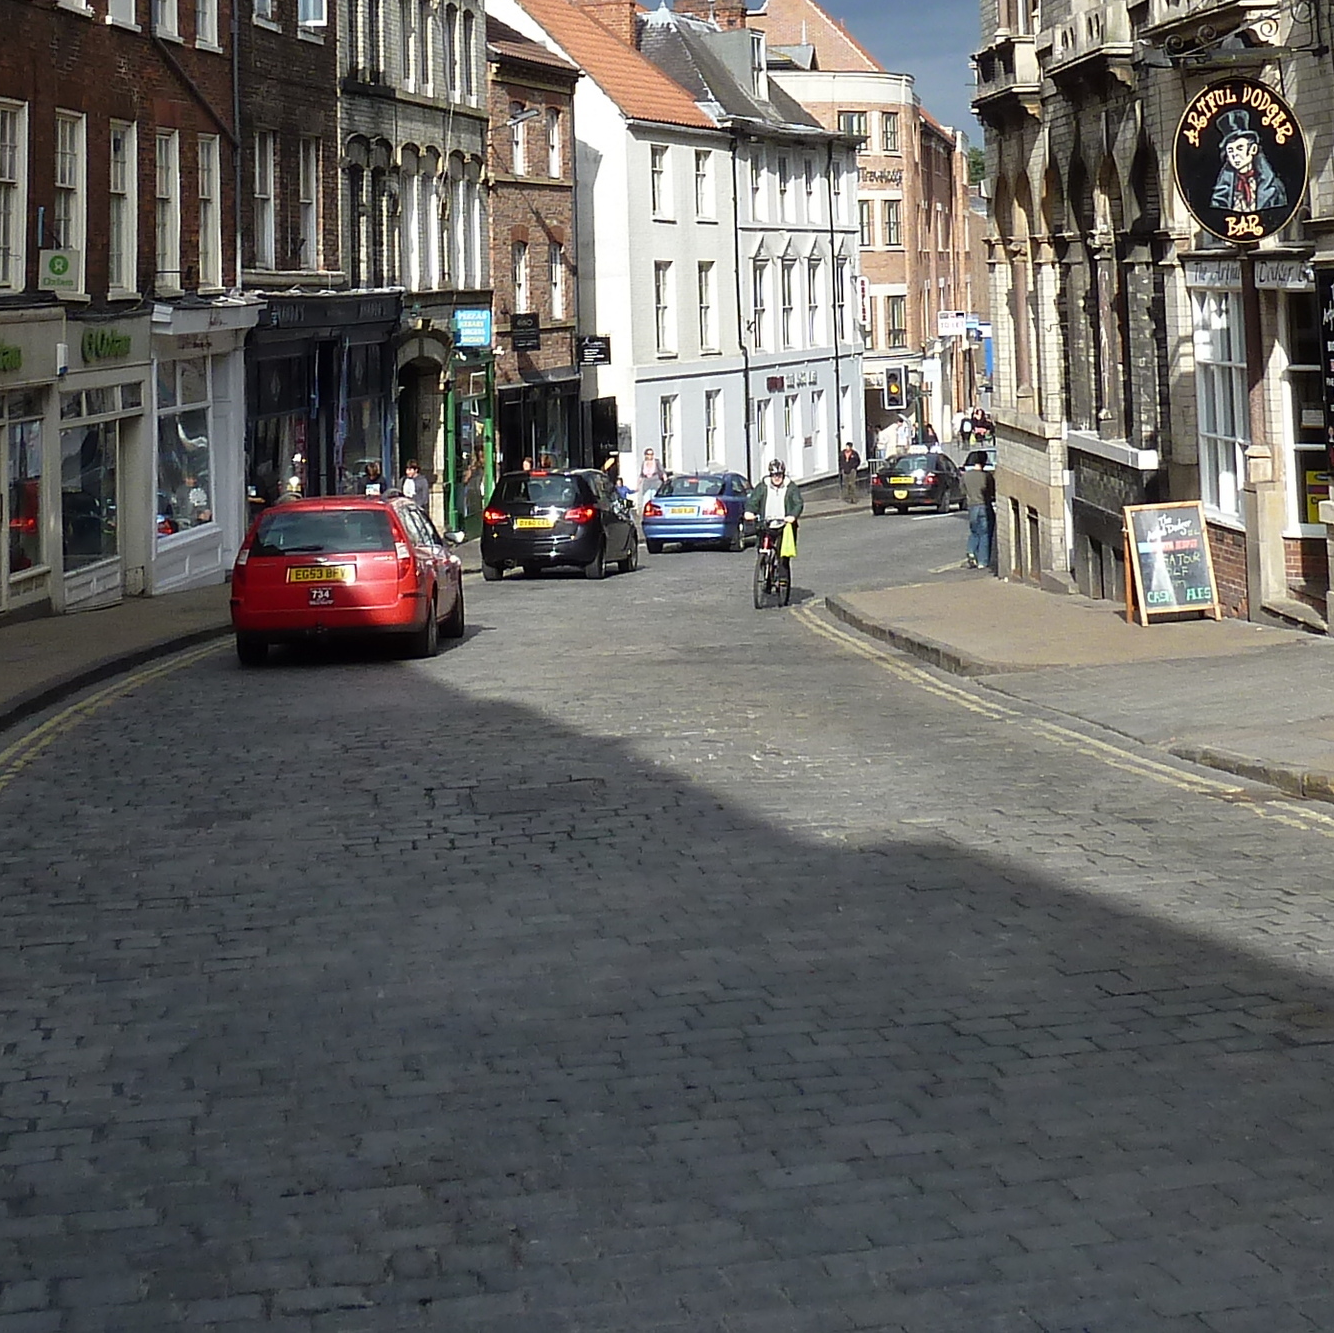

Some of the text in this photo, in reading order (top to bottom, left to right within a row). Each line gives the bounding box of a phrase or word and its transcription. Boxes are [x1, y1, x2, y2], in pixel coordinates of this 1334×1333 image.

[1225, 215, 1264, 237] BAR
[42, 277, 74, 287] Oxfam
[295, 568, 323, 580] EG53
[312, 590, 330, 599] 734
